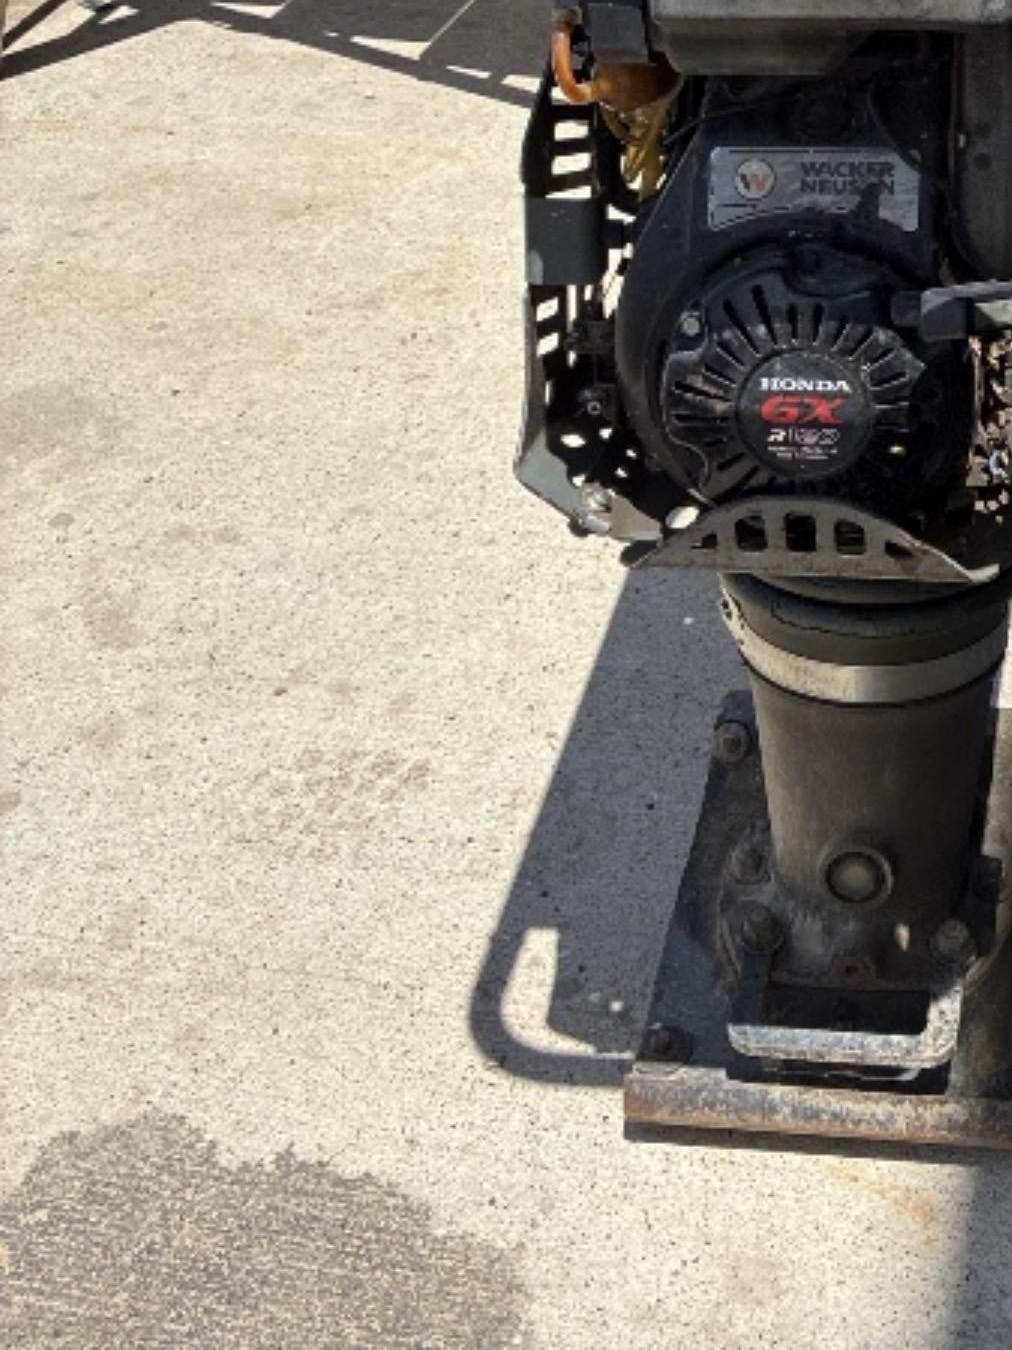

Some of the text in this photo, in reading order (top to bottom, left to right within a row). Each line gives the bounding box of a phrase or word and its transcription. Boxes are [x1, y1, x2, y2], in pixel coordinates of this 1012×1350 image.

[801, 161, 895, 177] WACKER
[801, 178, 895, 195] NEUSN
[760, 377, 851, 392] HONDA
[761, 393, 848, 425] GX
